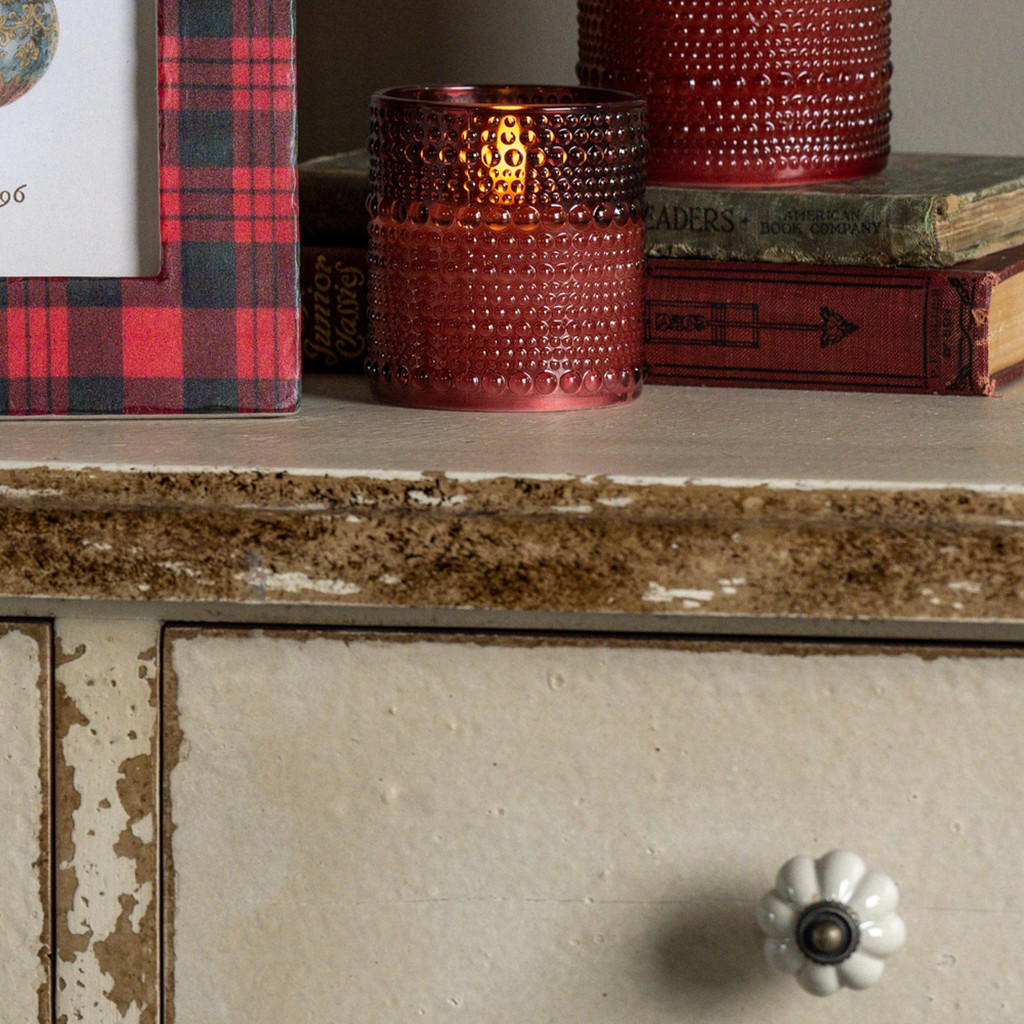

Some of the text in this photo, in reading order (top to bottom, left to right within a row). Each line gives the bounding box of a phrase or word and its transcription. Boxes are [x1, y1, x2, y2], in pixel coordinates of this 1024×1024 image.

[644, 205, 734, 233] EADERS
[759, 220, 881, 235] BOOK COMPANY
[783, 208, 861, 222] AMERICAN
[303, 254, 339, 366] Junior
[334, 259, 366, 359] Classics
